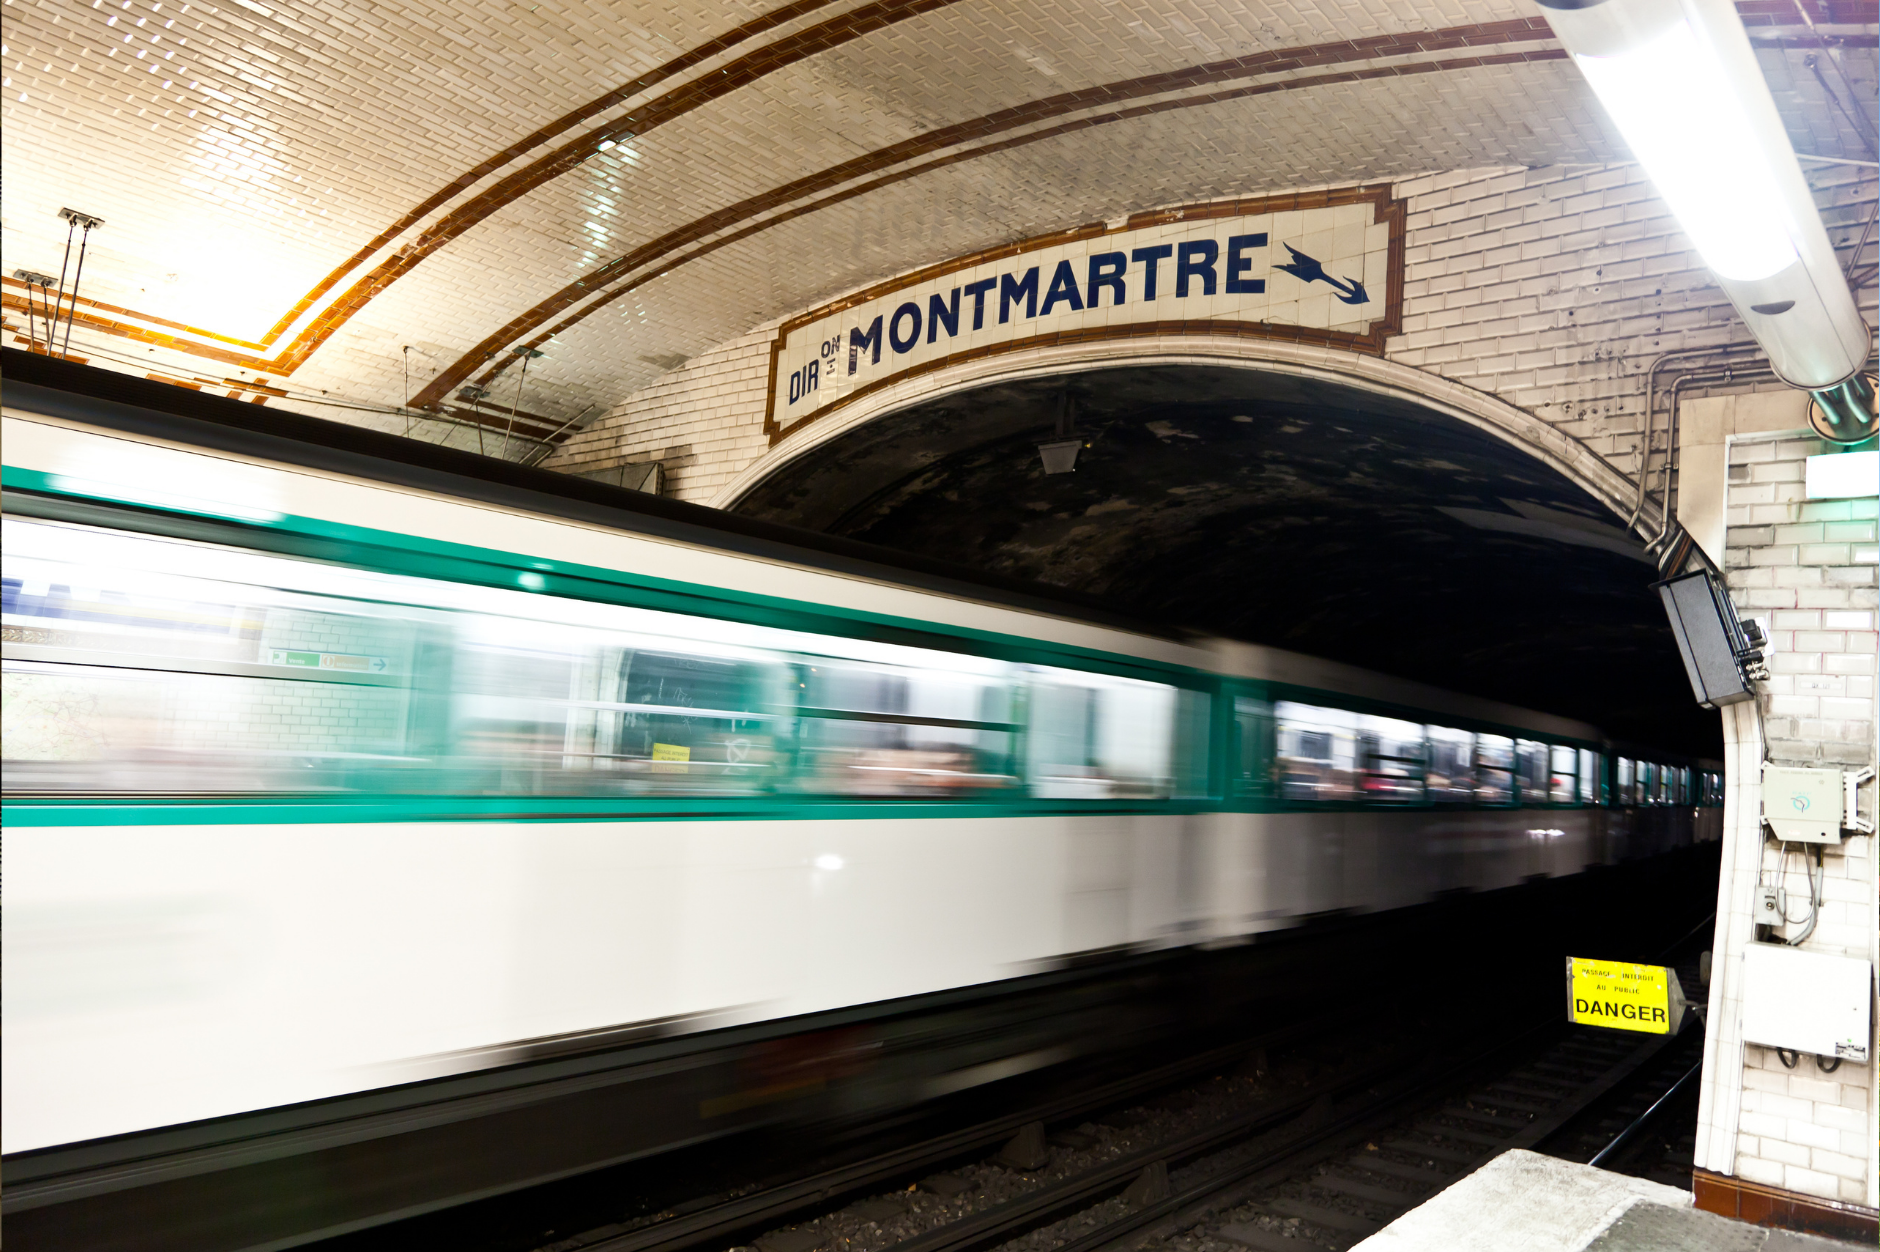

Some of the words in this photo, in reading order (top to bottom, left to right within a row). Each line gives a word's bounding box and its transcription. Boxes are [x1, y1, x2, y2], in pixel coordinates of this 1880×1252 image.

[847, 232, 1269, 377] MONTMARTRE
[1582, 968, 1611, 977] PASSAGE
[1622, 973, 1654, 982] INTERDIT
[1614, 986, 1640, 995] PUBLIC
[1576, 998, 1666, 1023] DANGER
